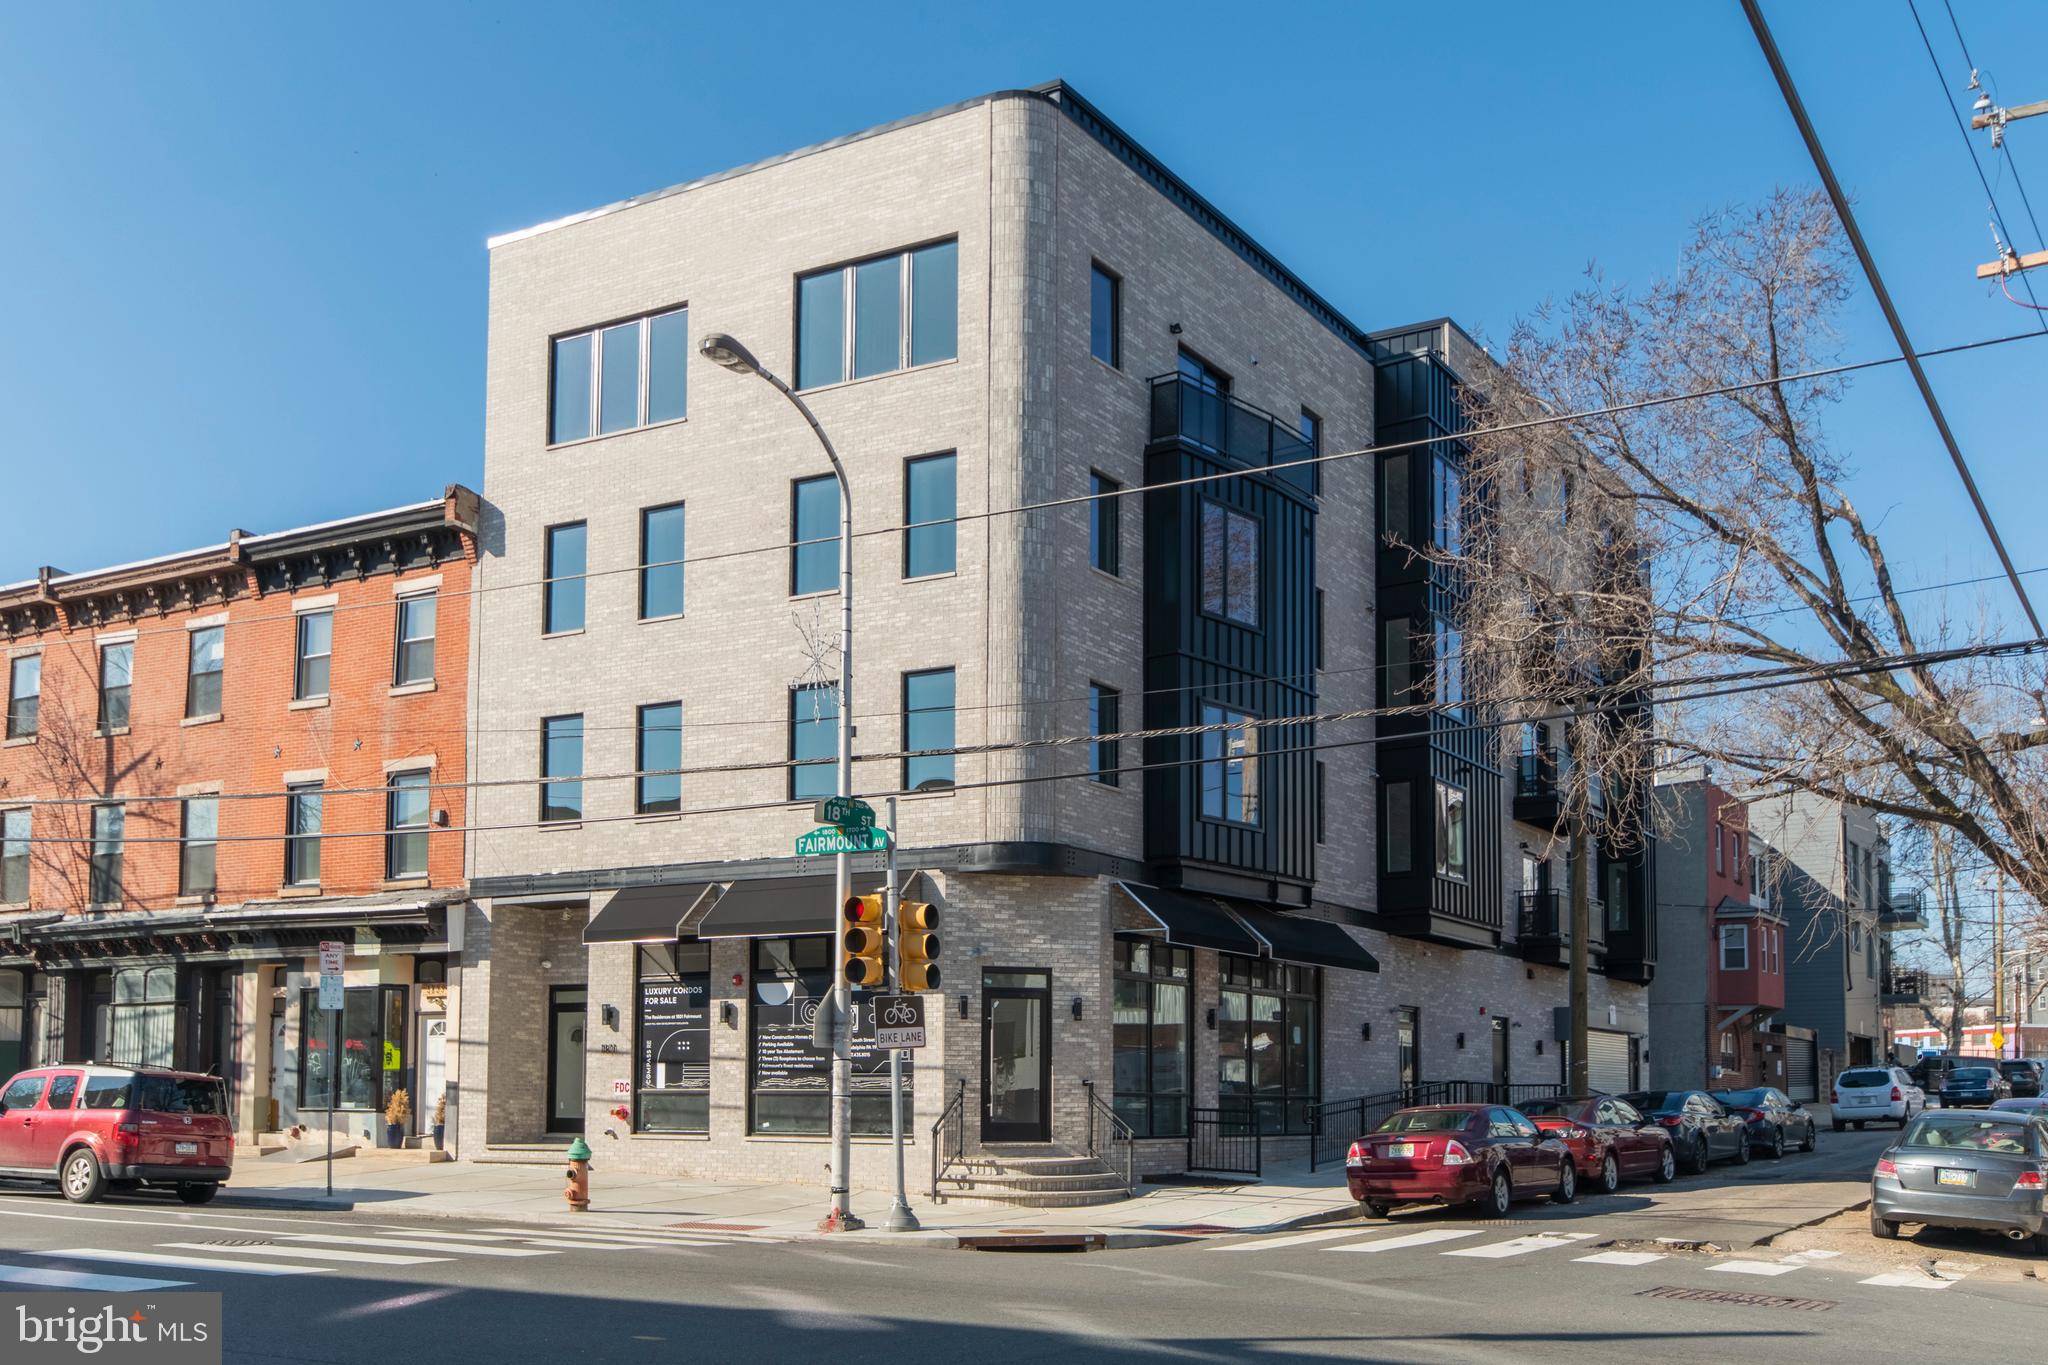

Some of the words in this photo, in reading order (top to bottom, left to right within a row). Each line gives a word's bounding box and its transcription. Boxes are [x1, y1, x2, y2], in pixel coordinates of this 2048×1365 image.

[861, 816, 872, 826] ST
[798, 834, 868, 852] FAIRMOUNT
[872, 837, 884, 848] AV
[644, 987, 672, 995] LUXURY
[672, 986, 702, 994] CONDOS
[880, 1033, 898, 1043] BIKE
[901, 1032, 922, 1042] LANE
[646, 1040, 652, 1049] RE
[615, 1082, 630, 1093] FDC
